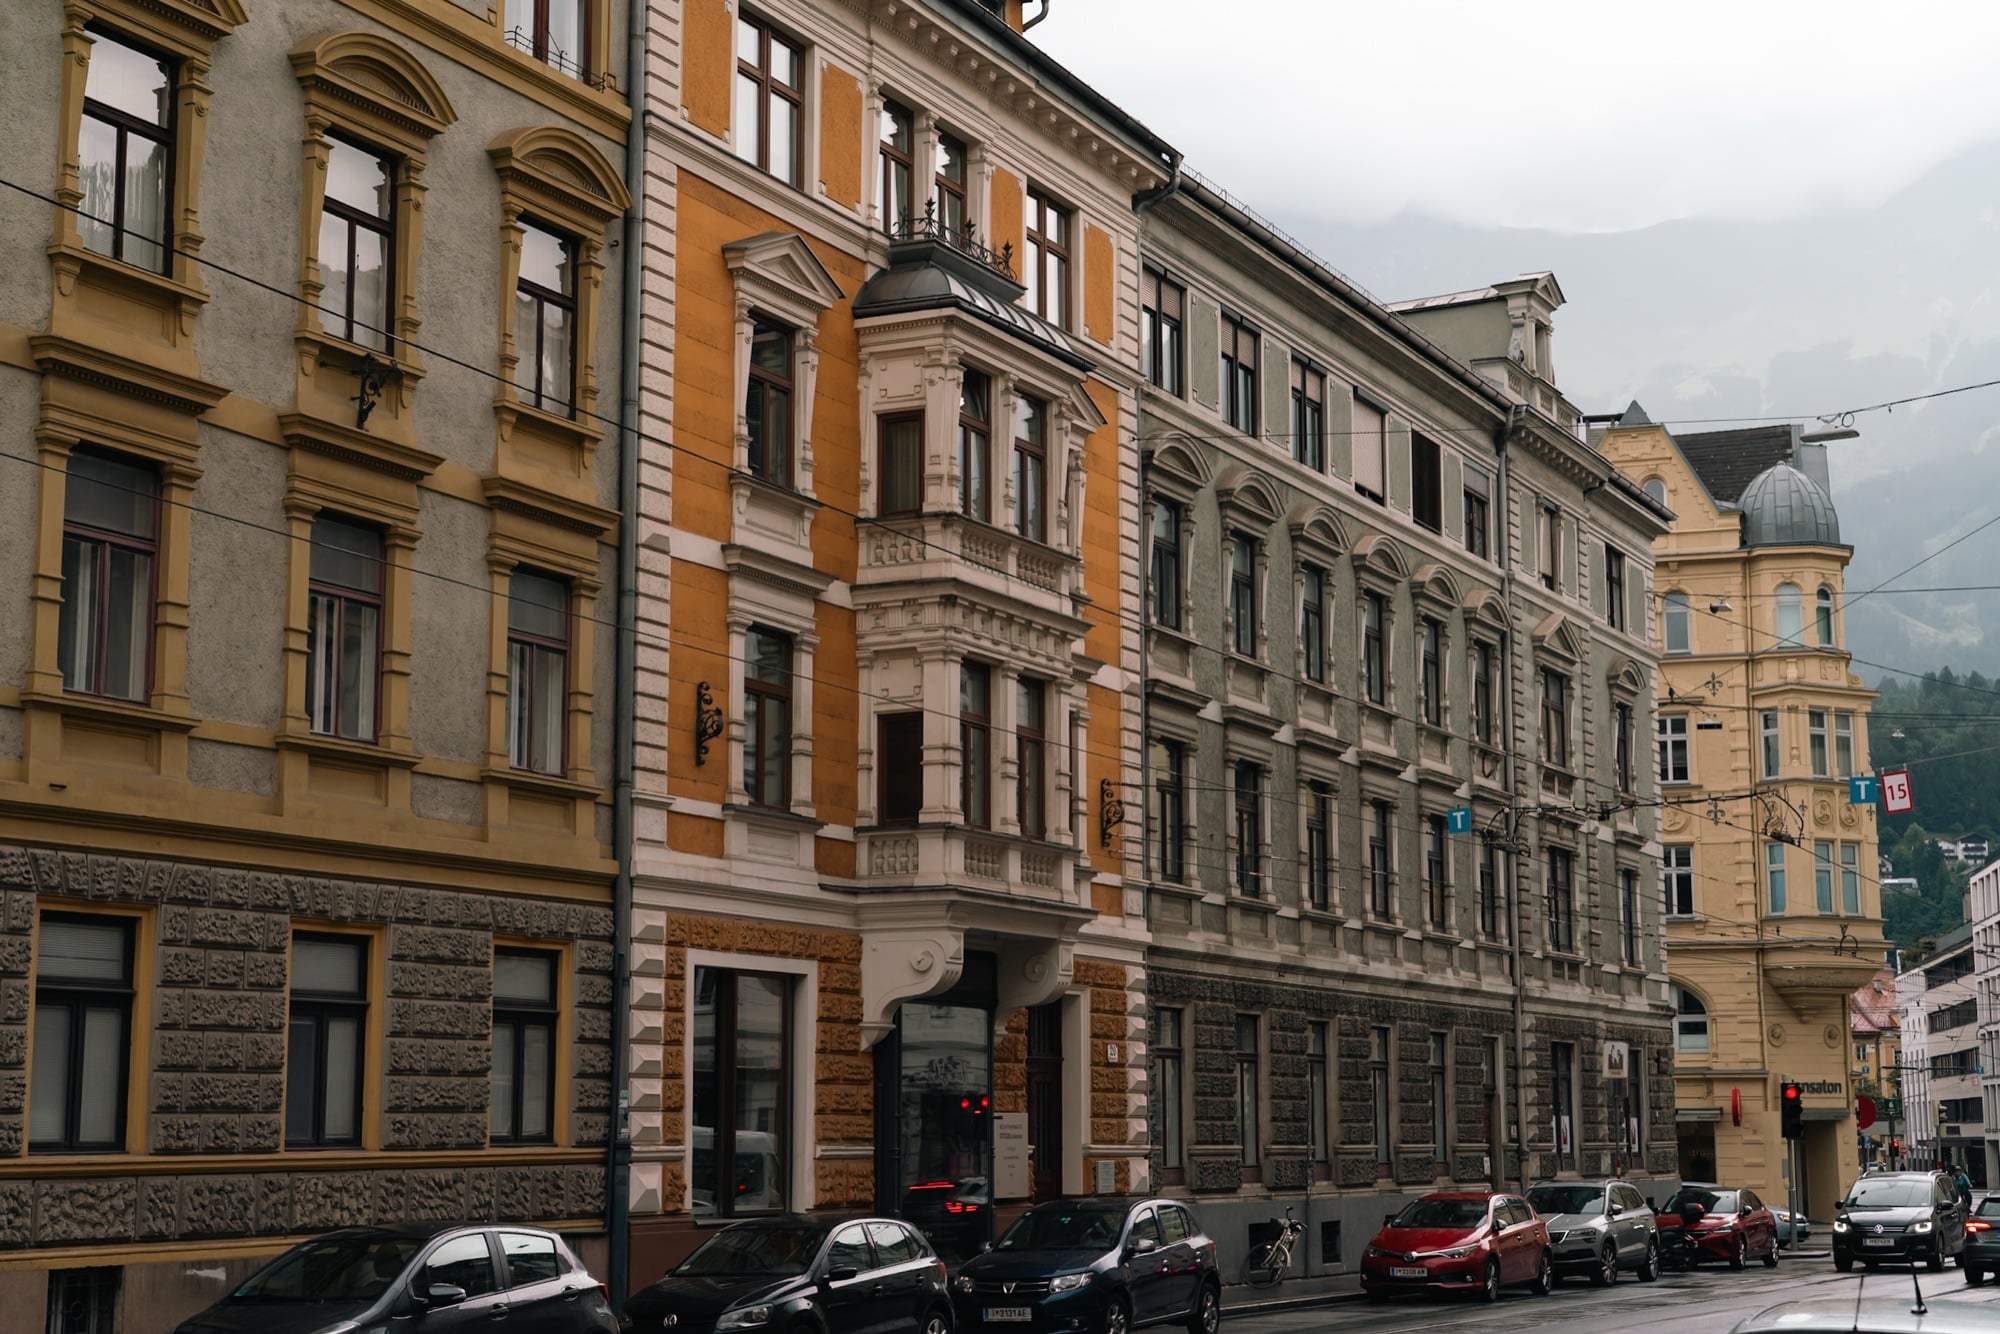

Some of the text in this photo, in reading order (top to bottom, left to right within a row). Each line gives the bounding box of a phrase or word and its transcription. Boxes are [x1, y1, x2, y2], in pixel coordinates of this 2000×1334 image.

[1855, 780, 1870, 800] T
[1887, 783, 1907, 801] 15
[1452, 811, 1465, 830] T
[1800, 1080, 1842, 1094] nsaton
